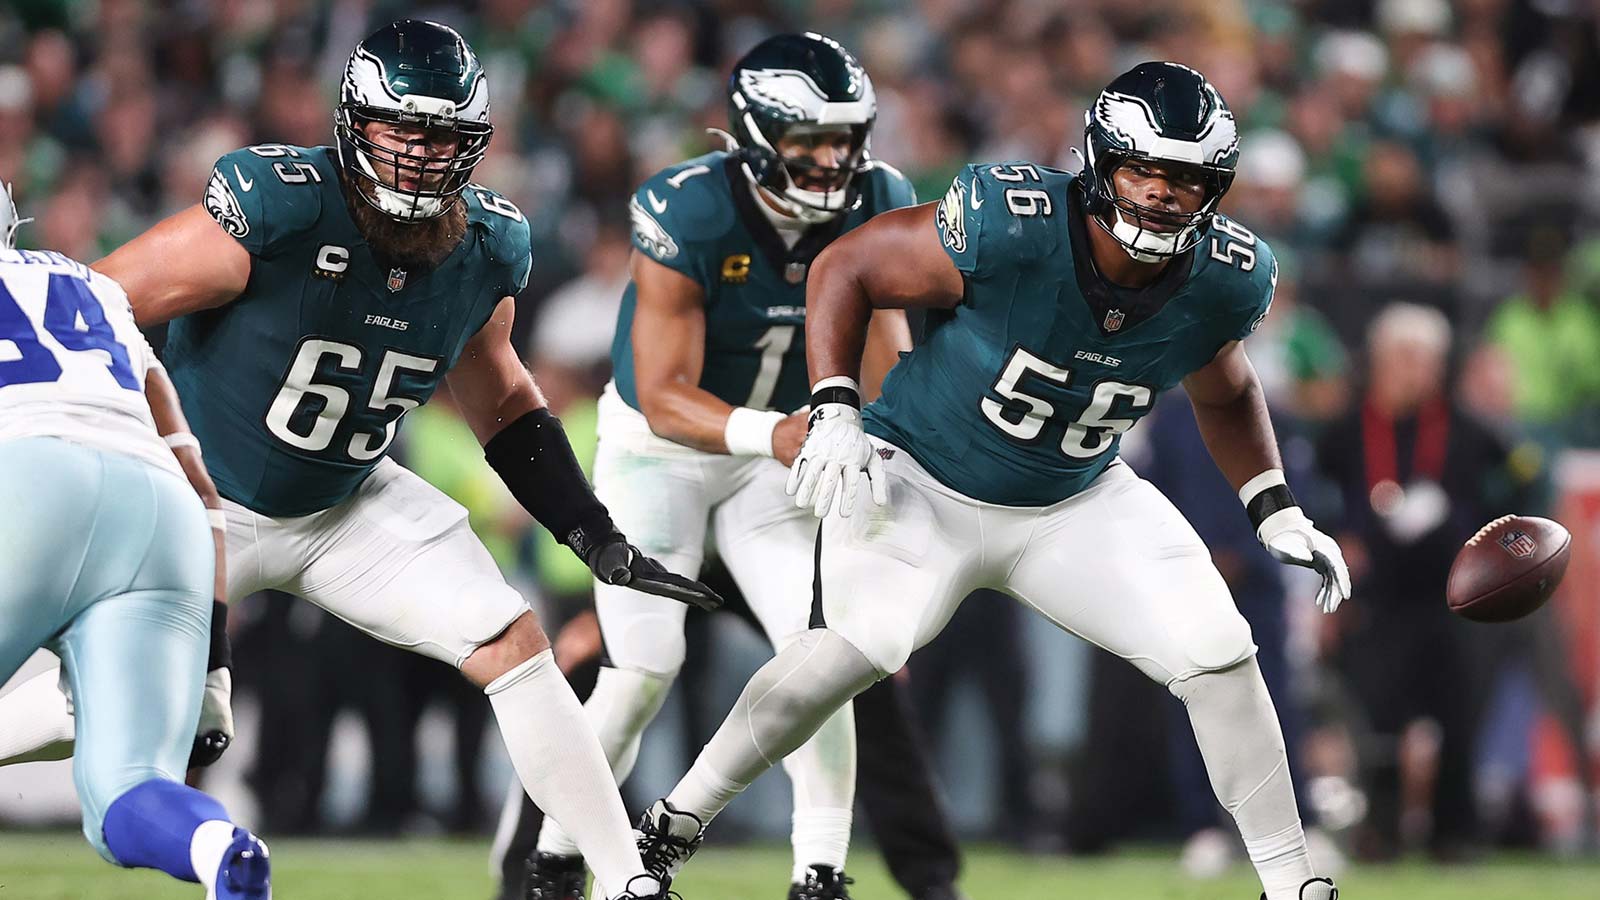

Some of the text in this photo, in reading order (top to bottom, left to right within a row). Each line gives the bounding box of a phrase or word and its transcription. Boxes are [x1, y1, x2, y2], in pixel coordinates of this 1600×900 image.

[248, 145, 323, 183] 65
[666, 165, 711, 189] 1
[990, 165, 1052, 215] 56
[317, 245, 349, 272] C
[1211, 214, 1255, 271] 56
[723, 255, 750, 277] C
[364, 314, 409, 331] EAGLES
[744, 325, 796, 411] 1
[1074, 350, 1122, 367] EAGLES
[264, 338, 440, 461] 65
[979, 346, 1152, 460] 56
[1509, 536, 1534, 556] NFL
